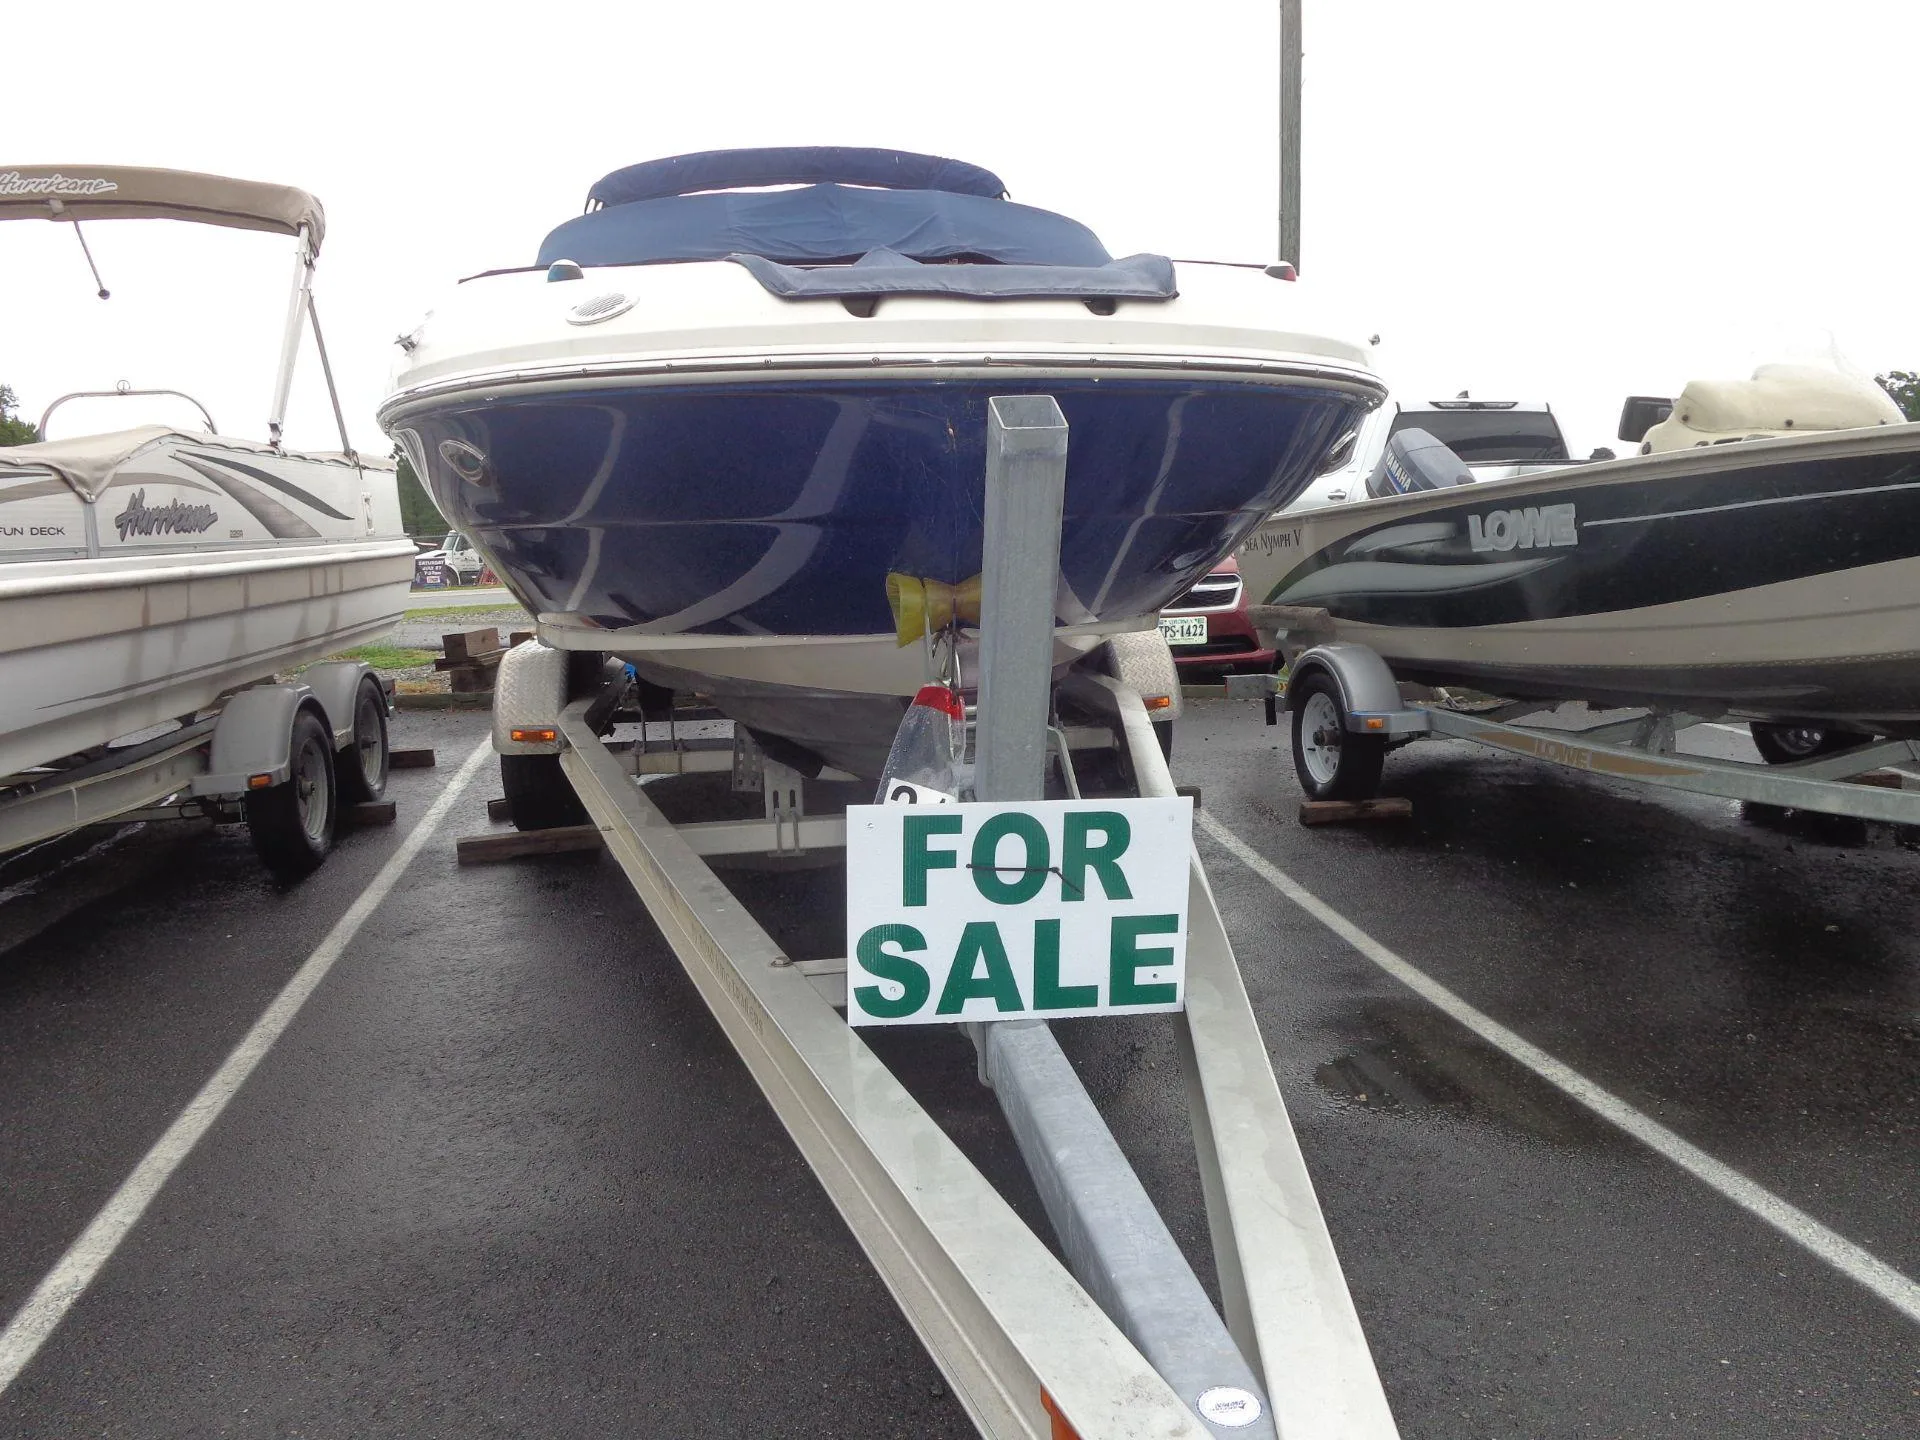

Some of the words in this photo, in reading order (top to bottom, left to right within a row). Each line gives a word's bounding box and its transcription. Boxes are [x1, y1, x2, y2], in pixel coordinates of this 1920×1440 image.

[0, 171, 118, 194] Hurricane
[1386, 449, 1411, 491] YAMAHA
[30, 526, 66, 536] DECK
[115, 487, 219, 542] Hurricane
[1467, 502, 1578, 552] LOWE
[1244, 537, 1259, 551] SEA
[1293, 529, 1302, 547] V
[903, 811, 1134, 907] FOR
[853, 913, 1179, 1019] SALE
